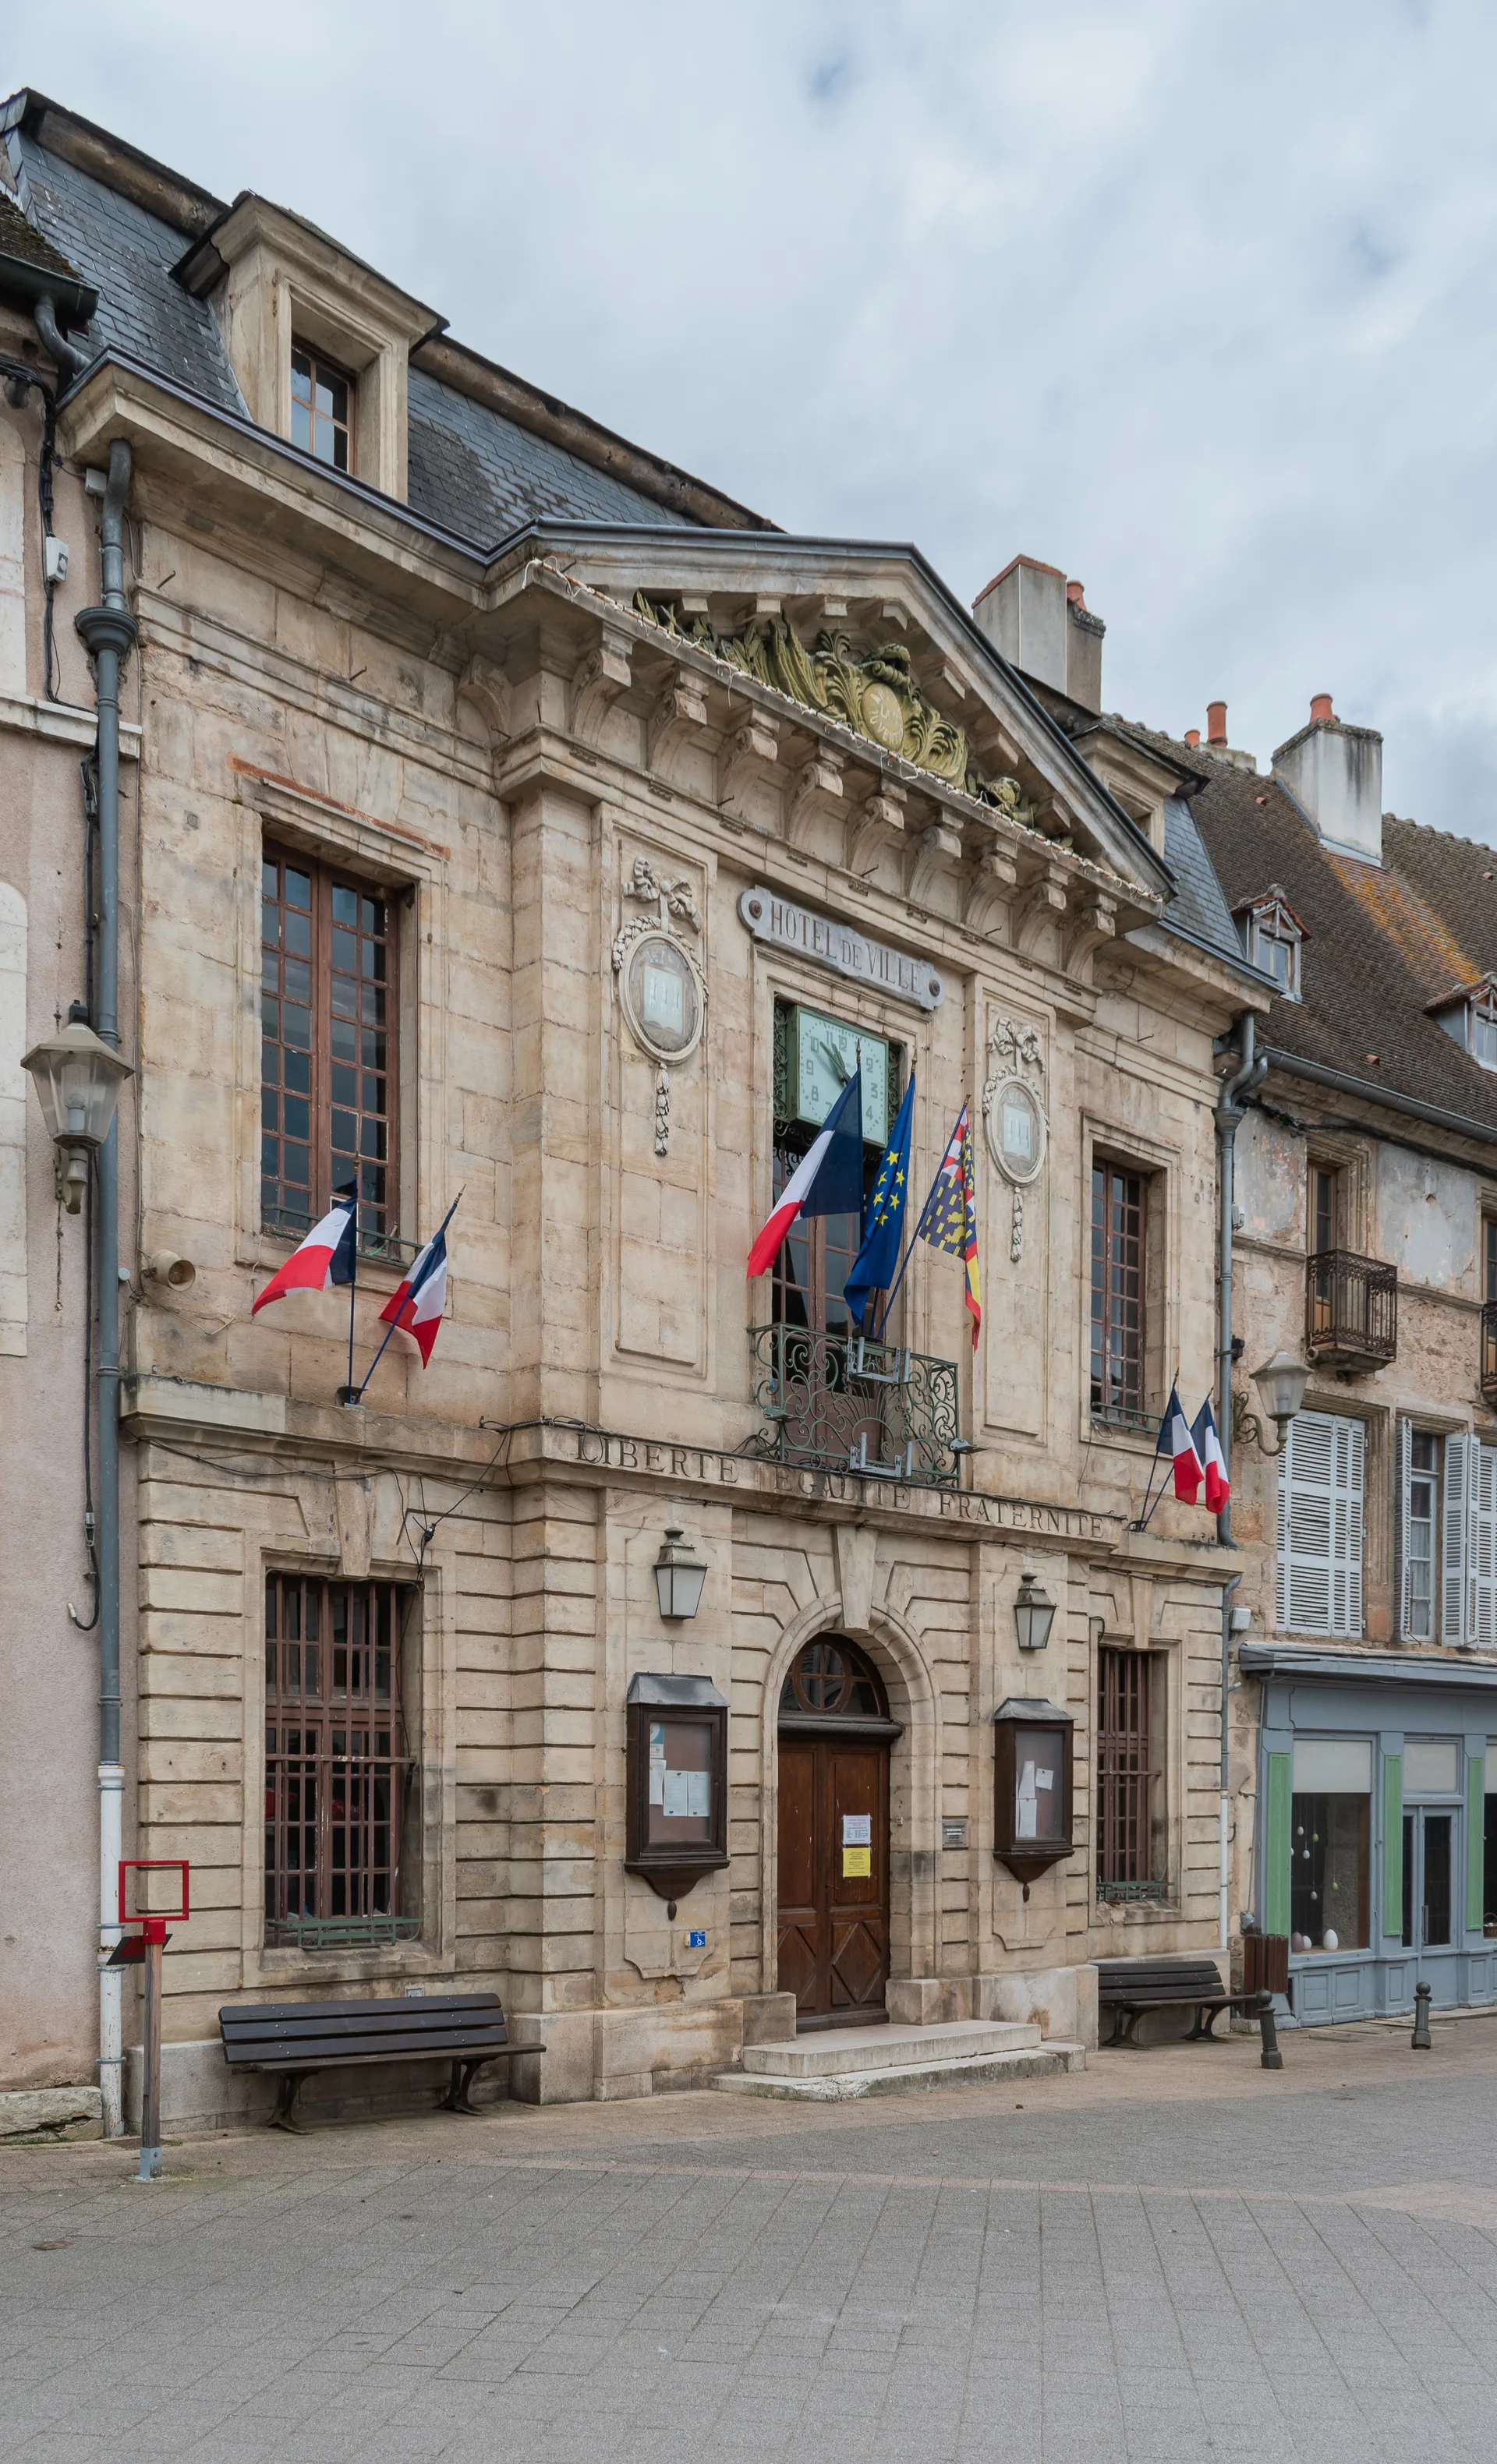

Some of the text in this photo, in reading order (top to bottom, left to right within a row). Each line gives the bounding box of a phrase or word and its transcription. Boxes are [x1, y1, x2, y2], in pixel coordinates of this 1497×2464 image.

[771, 900, 922, 995] HÔTEL DE VILLE
[810, 1036, 819, 1053] 10
[838, 1035, 847, 1052] 12
[806, 1059, 813, 1076] 9
[866, 1057, 873, 1073] 2
[811, 1085, 819, 1102] 8
[871, 1082, 878, 1099] 3
[865, 1105, 873, 1121] 4
[575, 1433, 739, 1483] LIBERTE
[938, 1492, 1105, 1539] FRATERNITE
